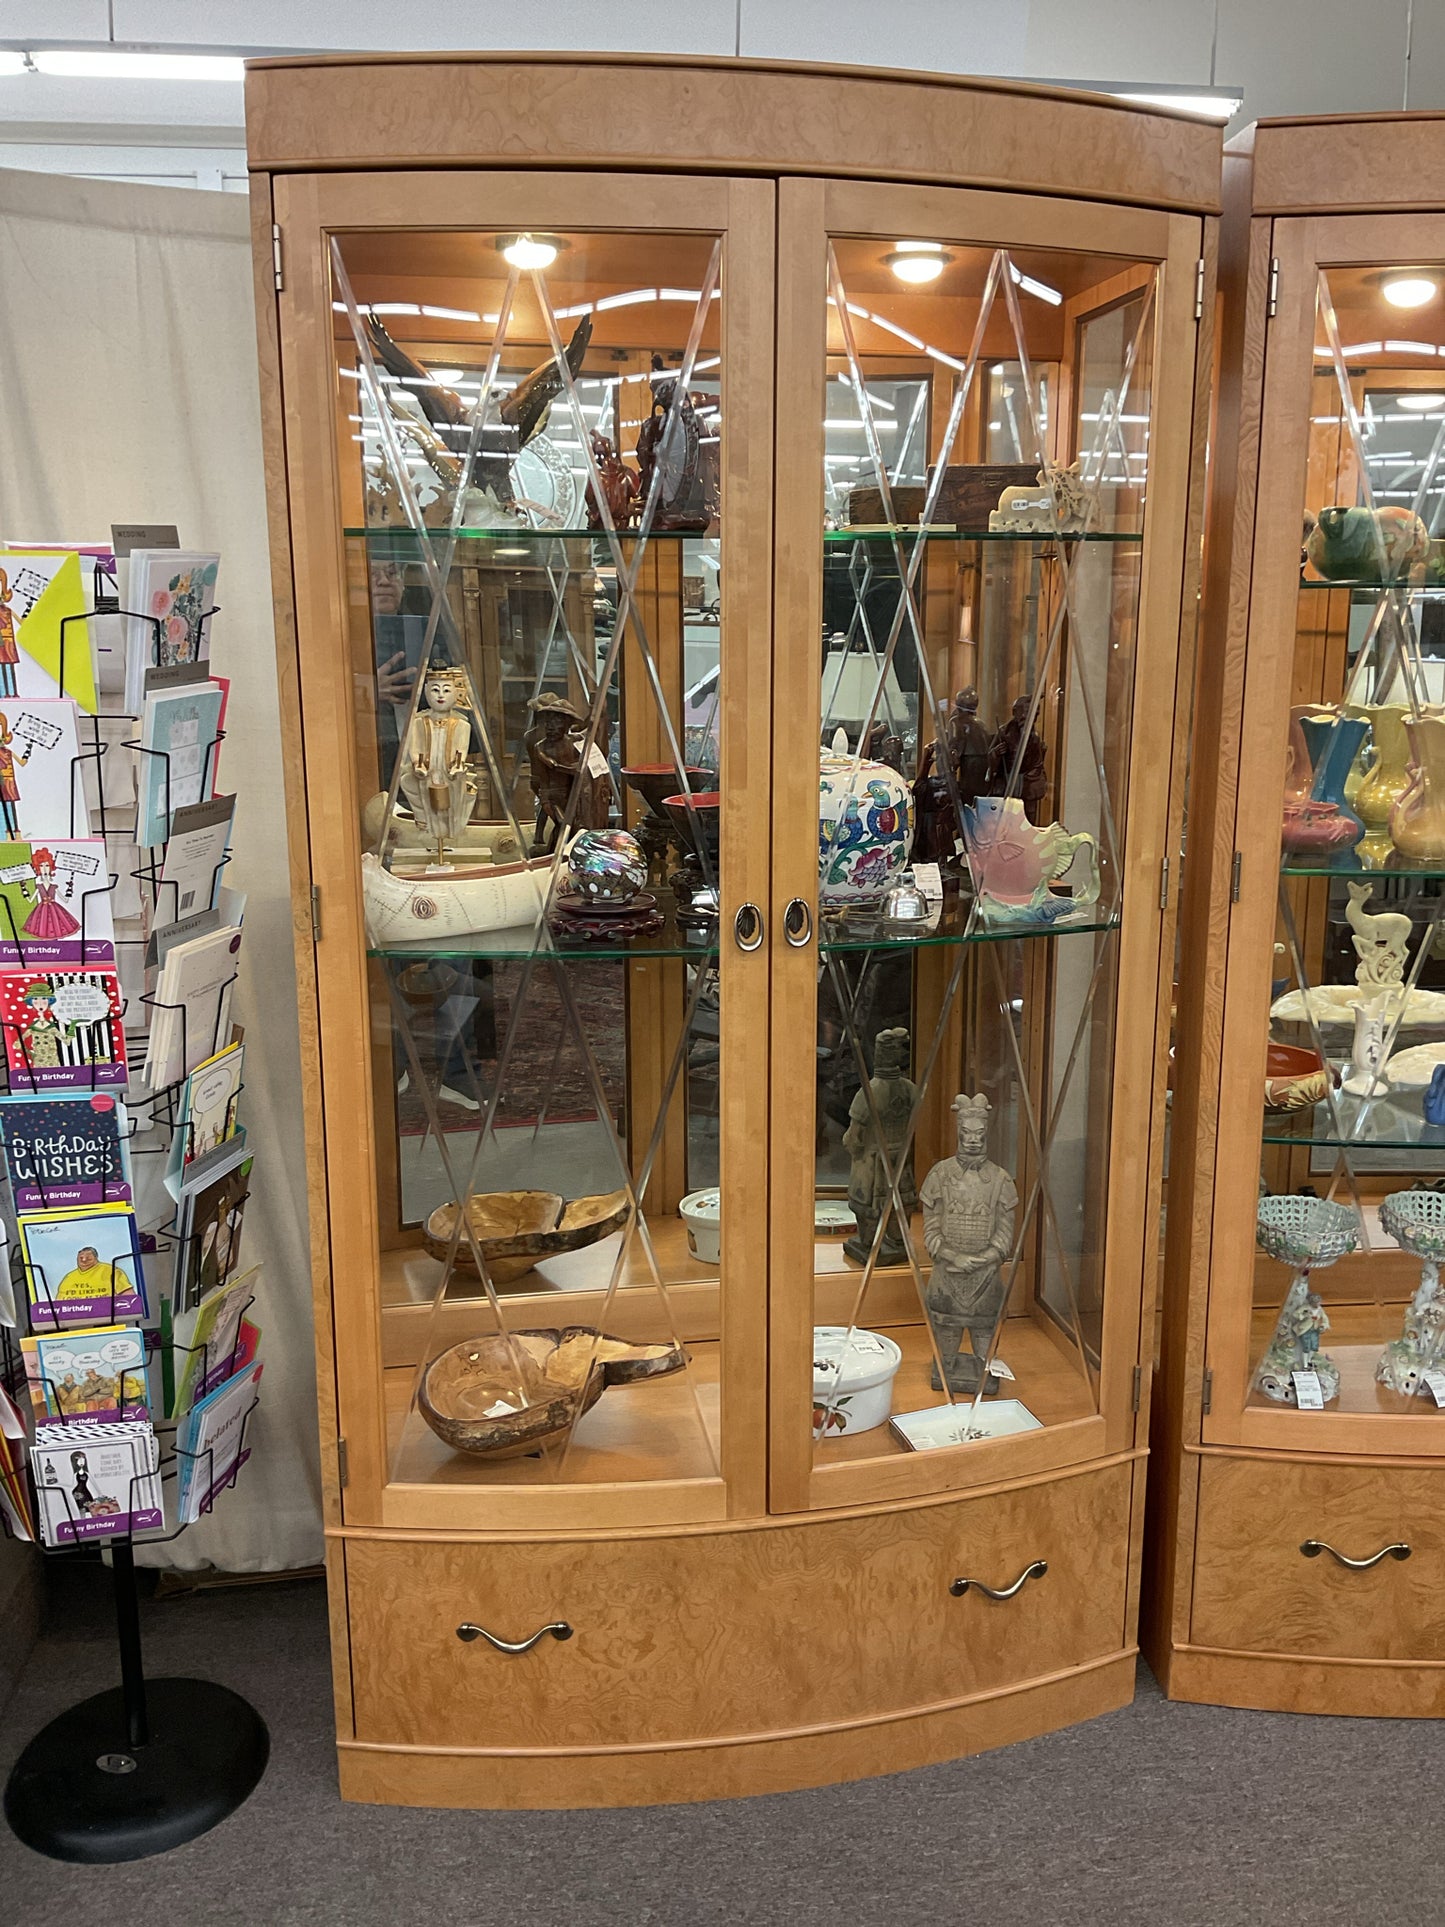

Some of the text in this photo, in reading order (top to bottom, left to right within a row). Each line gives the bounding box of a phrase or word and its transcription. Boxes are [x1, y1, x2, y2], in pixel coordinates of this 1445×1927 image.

[117, 530, 146, 538] WEDDING
[28, 946, 60, 955] Birthday
[15, 1153, 114, 1180] WISHES
[49, 1191, 81, 1199] Birthday
[61, 1305, 93, 1313] Birthday
[68, 1417, 99, 1426] Birthday
[64, 1521, 116, 1534] Funy Birthday
